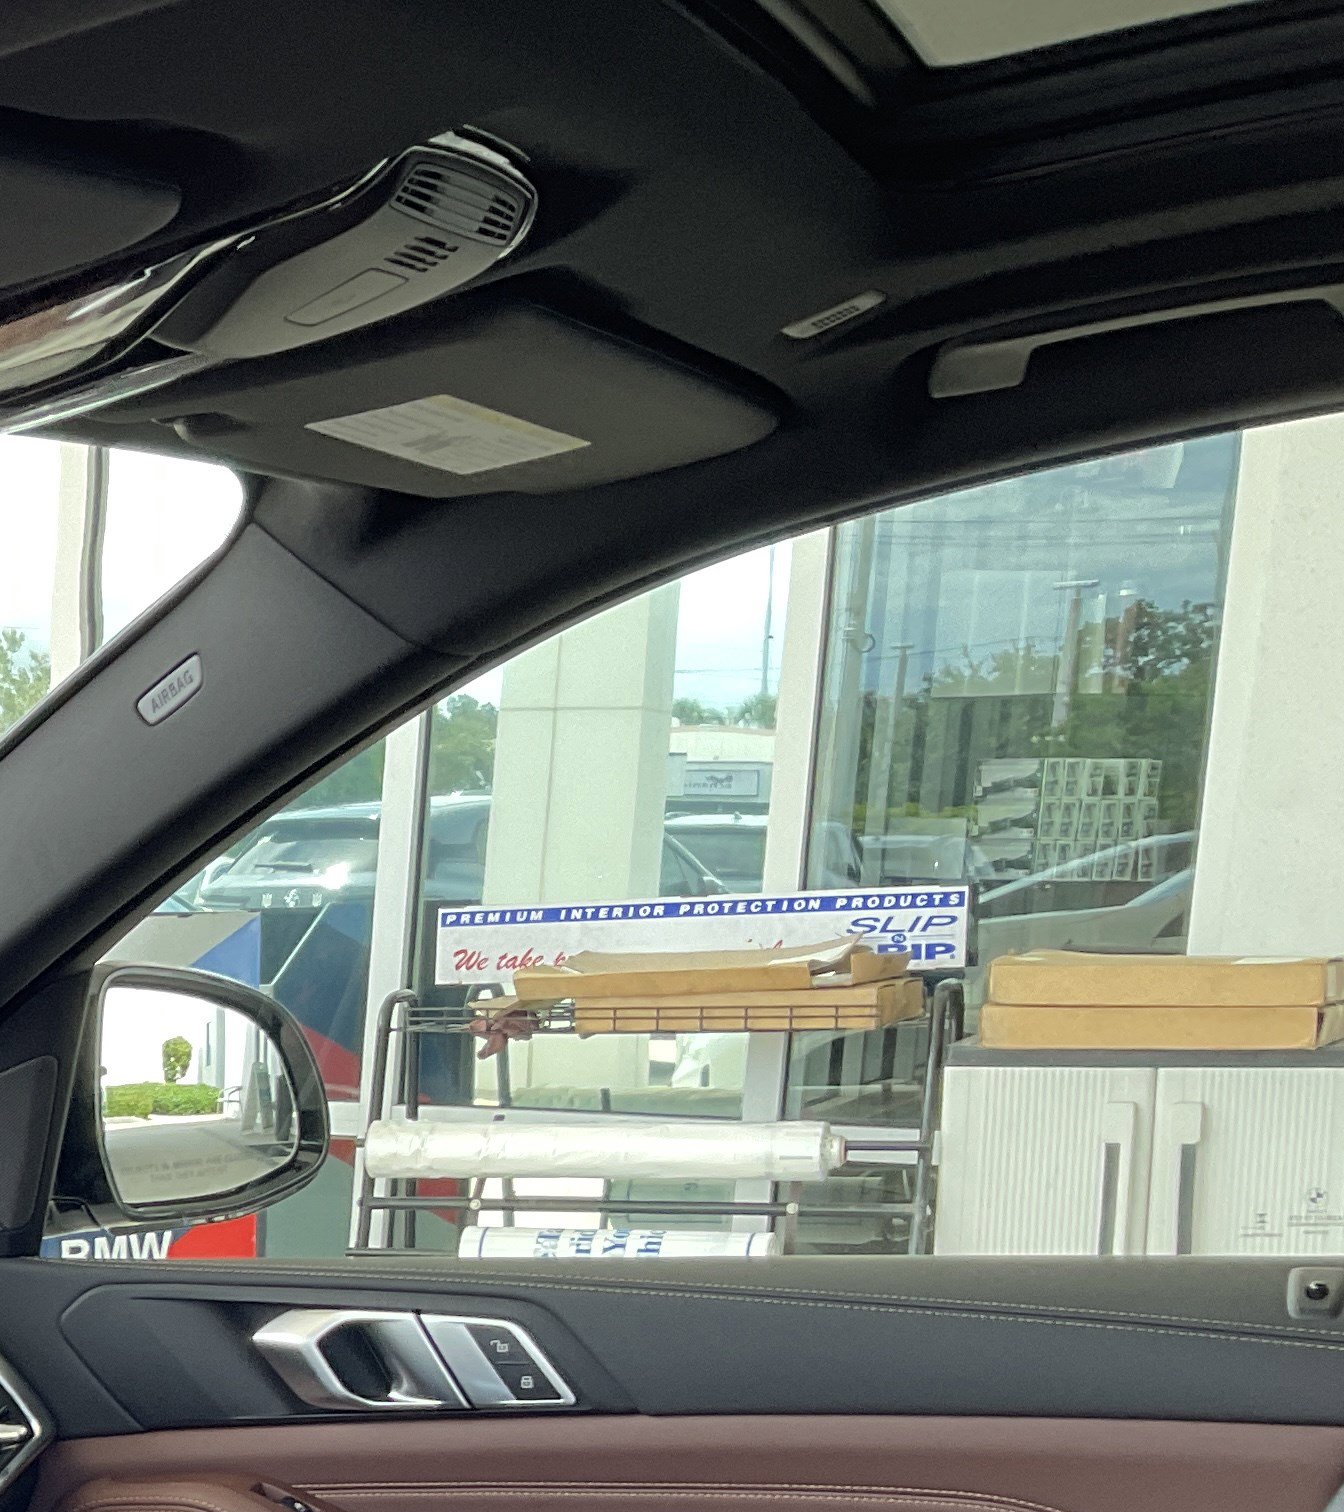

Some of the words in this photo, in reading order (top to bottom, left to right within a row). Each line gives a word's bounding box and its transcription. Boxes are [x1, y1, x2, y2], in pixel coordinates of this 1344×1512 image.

[151, 670, 193, 713] AIRBAG
[445, 910, 544, 925] PREMIUM
[560, 905, 665, 920] INTERIOR
[679, 899, 821, 916] PROTECTION
[835, 893, 961, 910] PRODUCTS
[846, 914, 958, 935] SLIP
[453, 949, 490, 971] We
[495, 947, 544, 971] take
[61, 1230, 173, 1259] BMW
